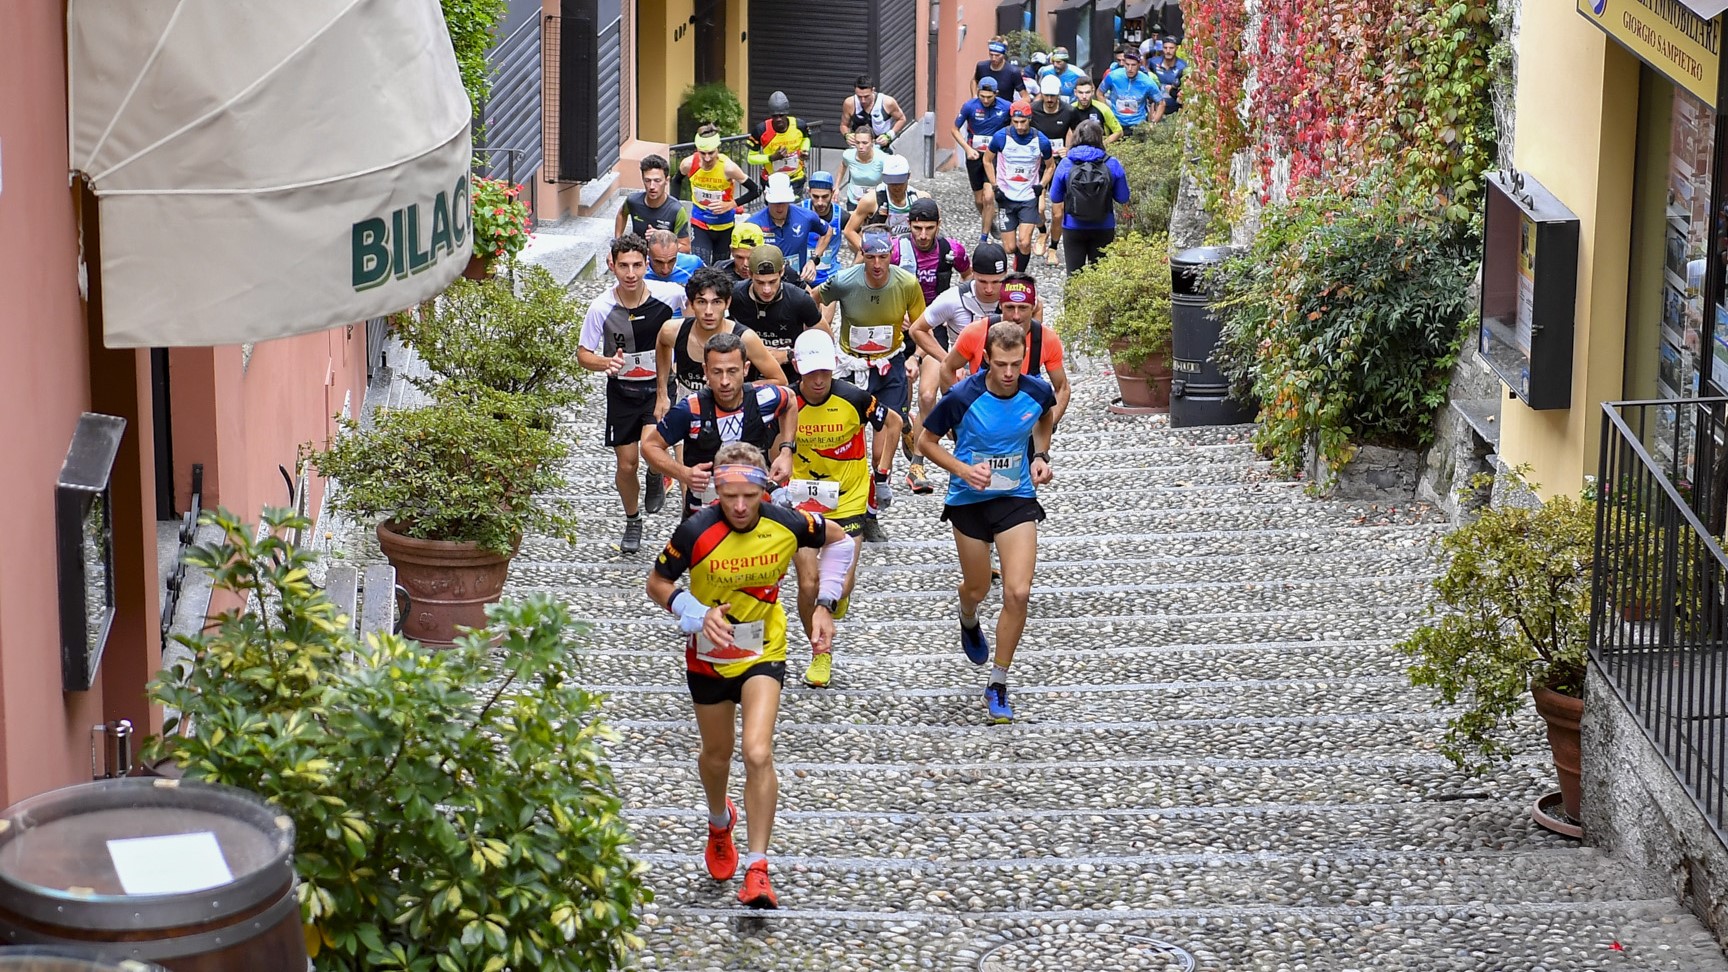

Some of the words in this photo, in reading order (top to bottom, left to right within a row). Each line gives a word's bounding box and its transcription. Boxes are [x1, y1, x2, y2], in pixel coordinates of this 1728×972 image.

[1623, 11, 1656, 48] GIORGIO
[1657, 35, 1703, 81] SAMPIETRO
[868, 331, 874, 339] 2
[634, 357, 640, 365] 8
[797, 422, 844, 436] egarun
[807, 486, 818, 496] 13
[710, 552, 779, 573] pegarun
[706, 573, 733, 584] TEAM
[745, 568, 782, 582] BEAUTY
